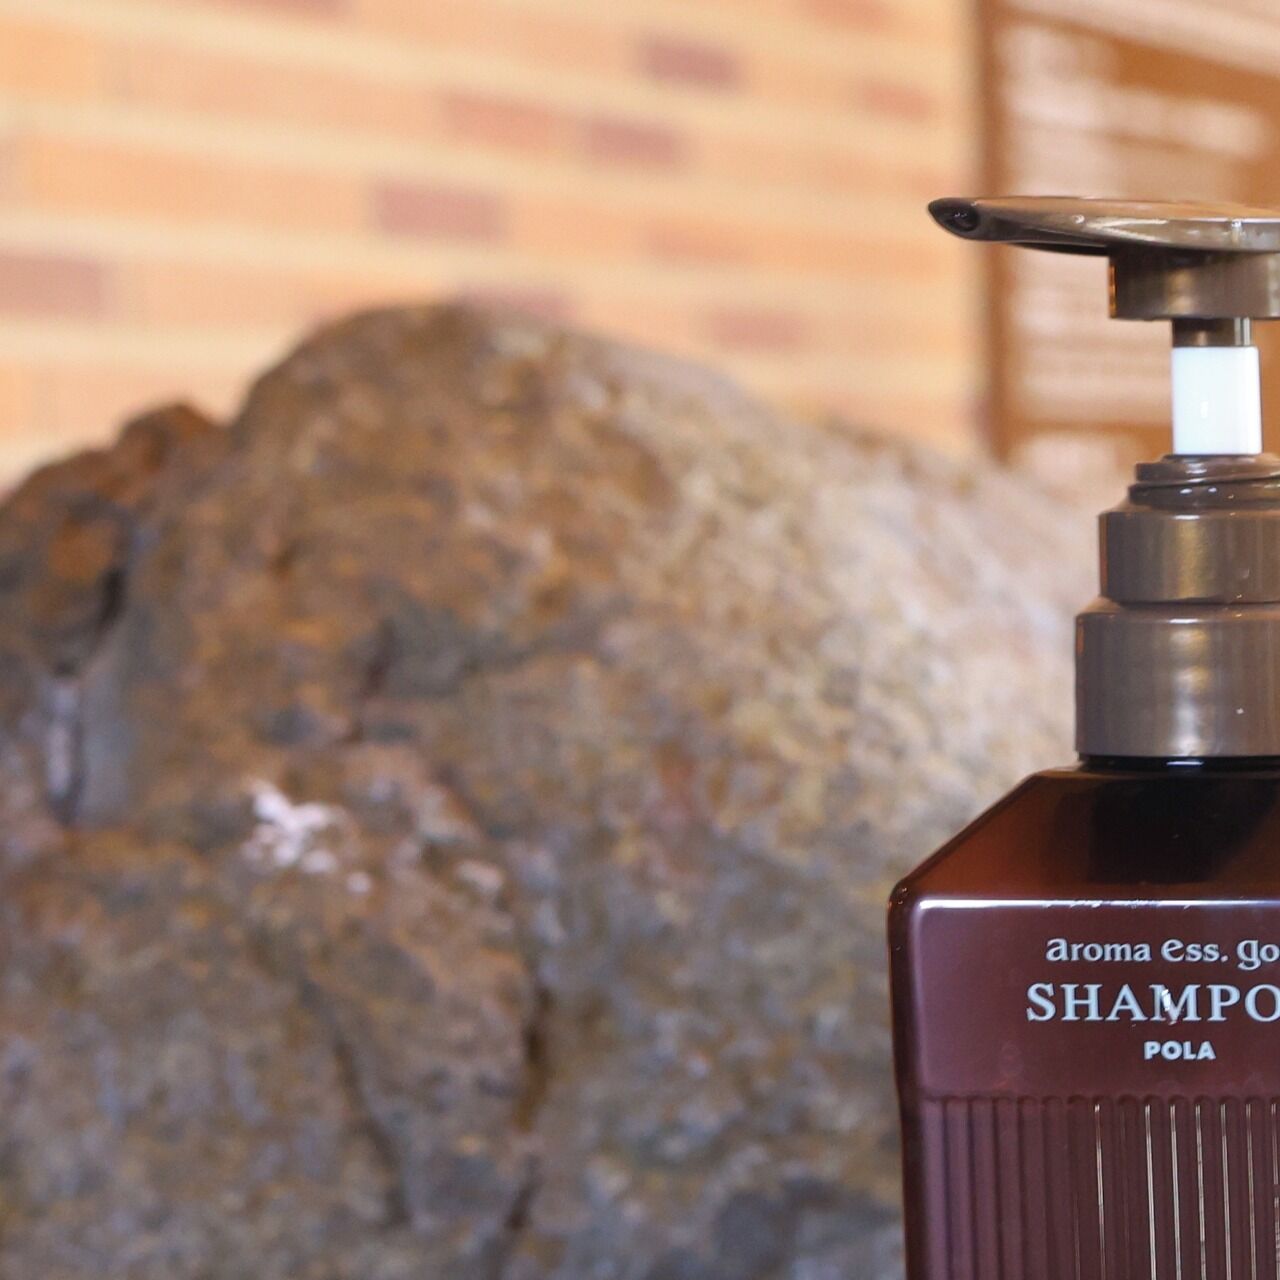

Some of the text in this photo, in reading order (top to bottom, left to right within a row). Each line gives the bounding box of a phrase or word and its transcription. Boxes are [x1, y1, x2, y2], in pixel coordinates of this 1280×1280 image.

[1046, 938, 1152, 962] aroma
[1160, 938, 1229, 963] ess.
[1143, 1040, 1217, 1061] POLA
